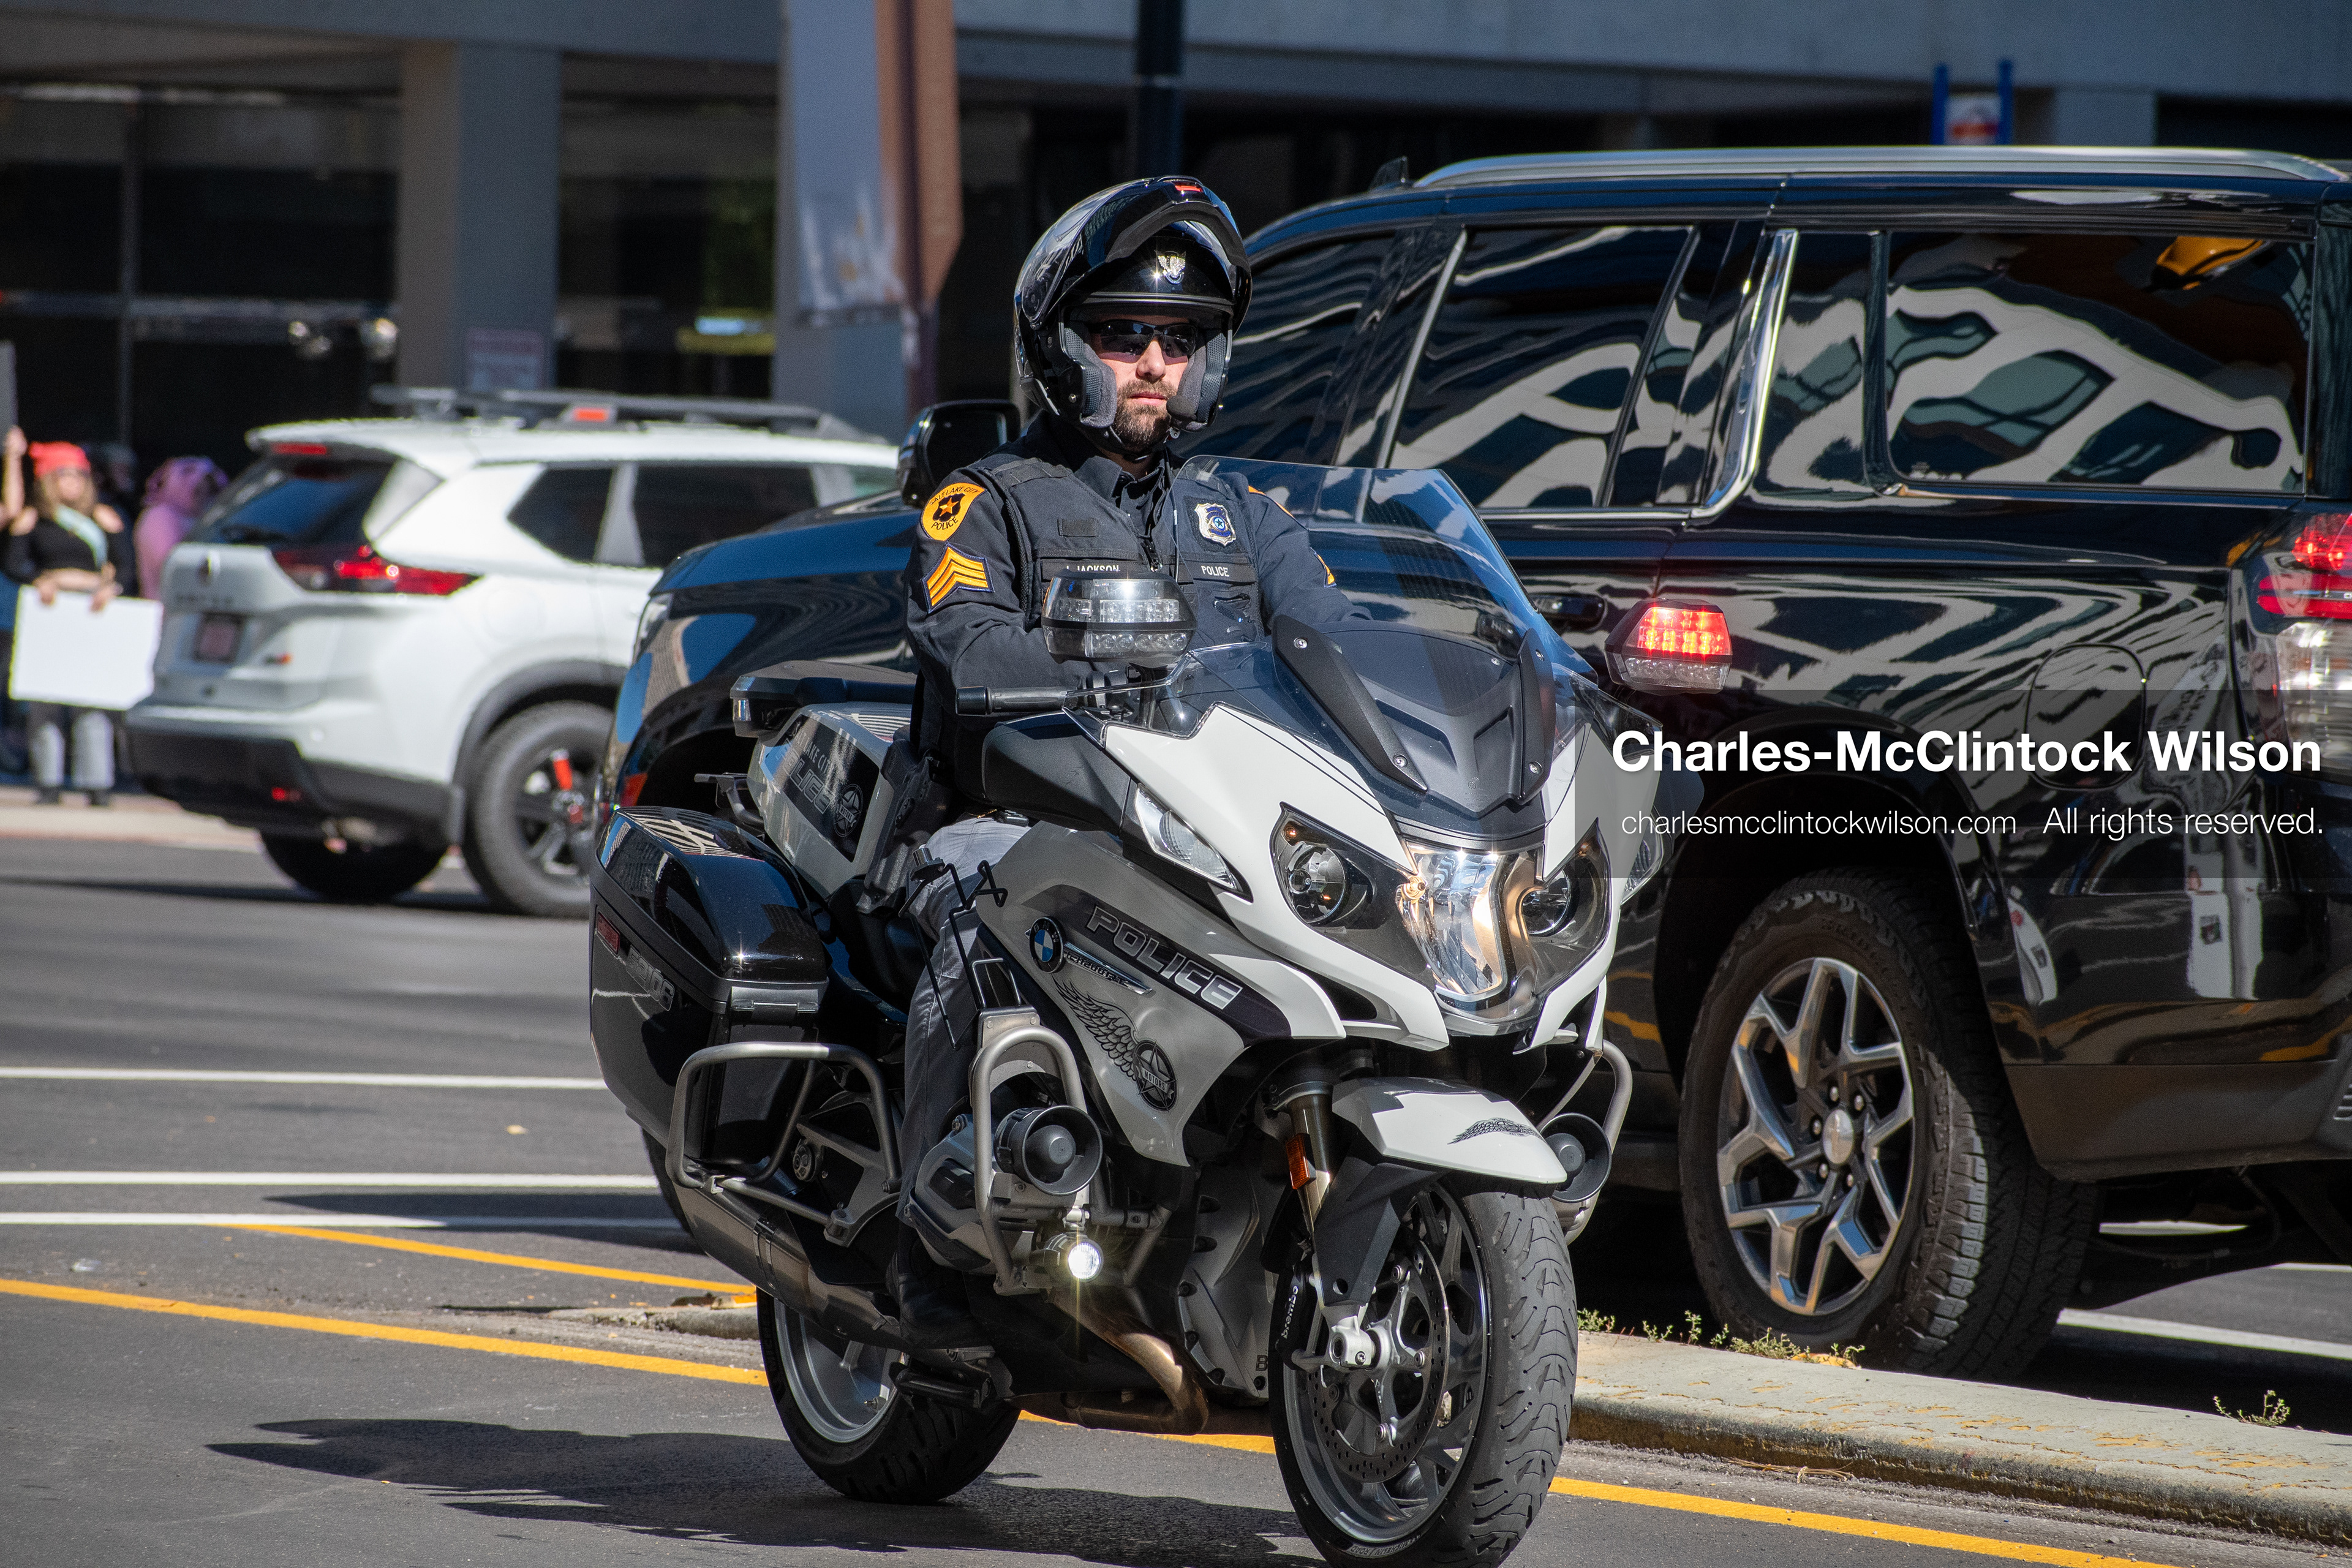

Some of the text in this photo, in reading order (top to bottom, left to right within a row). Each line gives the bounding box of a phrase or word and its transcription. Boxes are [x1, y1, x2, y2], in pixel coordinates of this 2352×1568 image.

[930, 491, 945, 505] SALT
[946, 486, 965, 495] LAKE
[930, 516, 959, 530] POLICE
[1200, 565, 1230, 577] POLICE
[1033, 920, 1060, 943] BMW
[1085, 906, 1243, 1010] POLICE
[1144, 1069, 1165, 1091] MOTORS
[1281, 1285, 1298, 1339] brembo
[1351, 1545, 1371, 1555] ROAD
